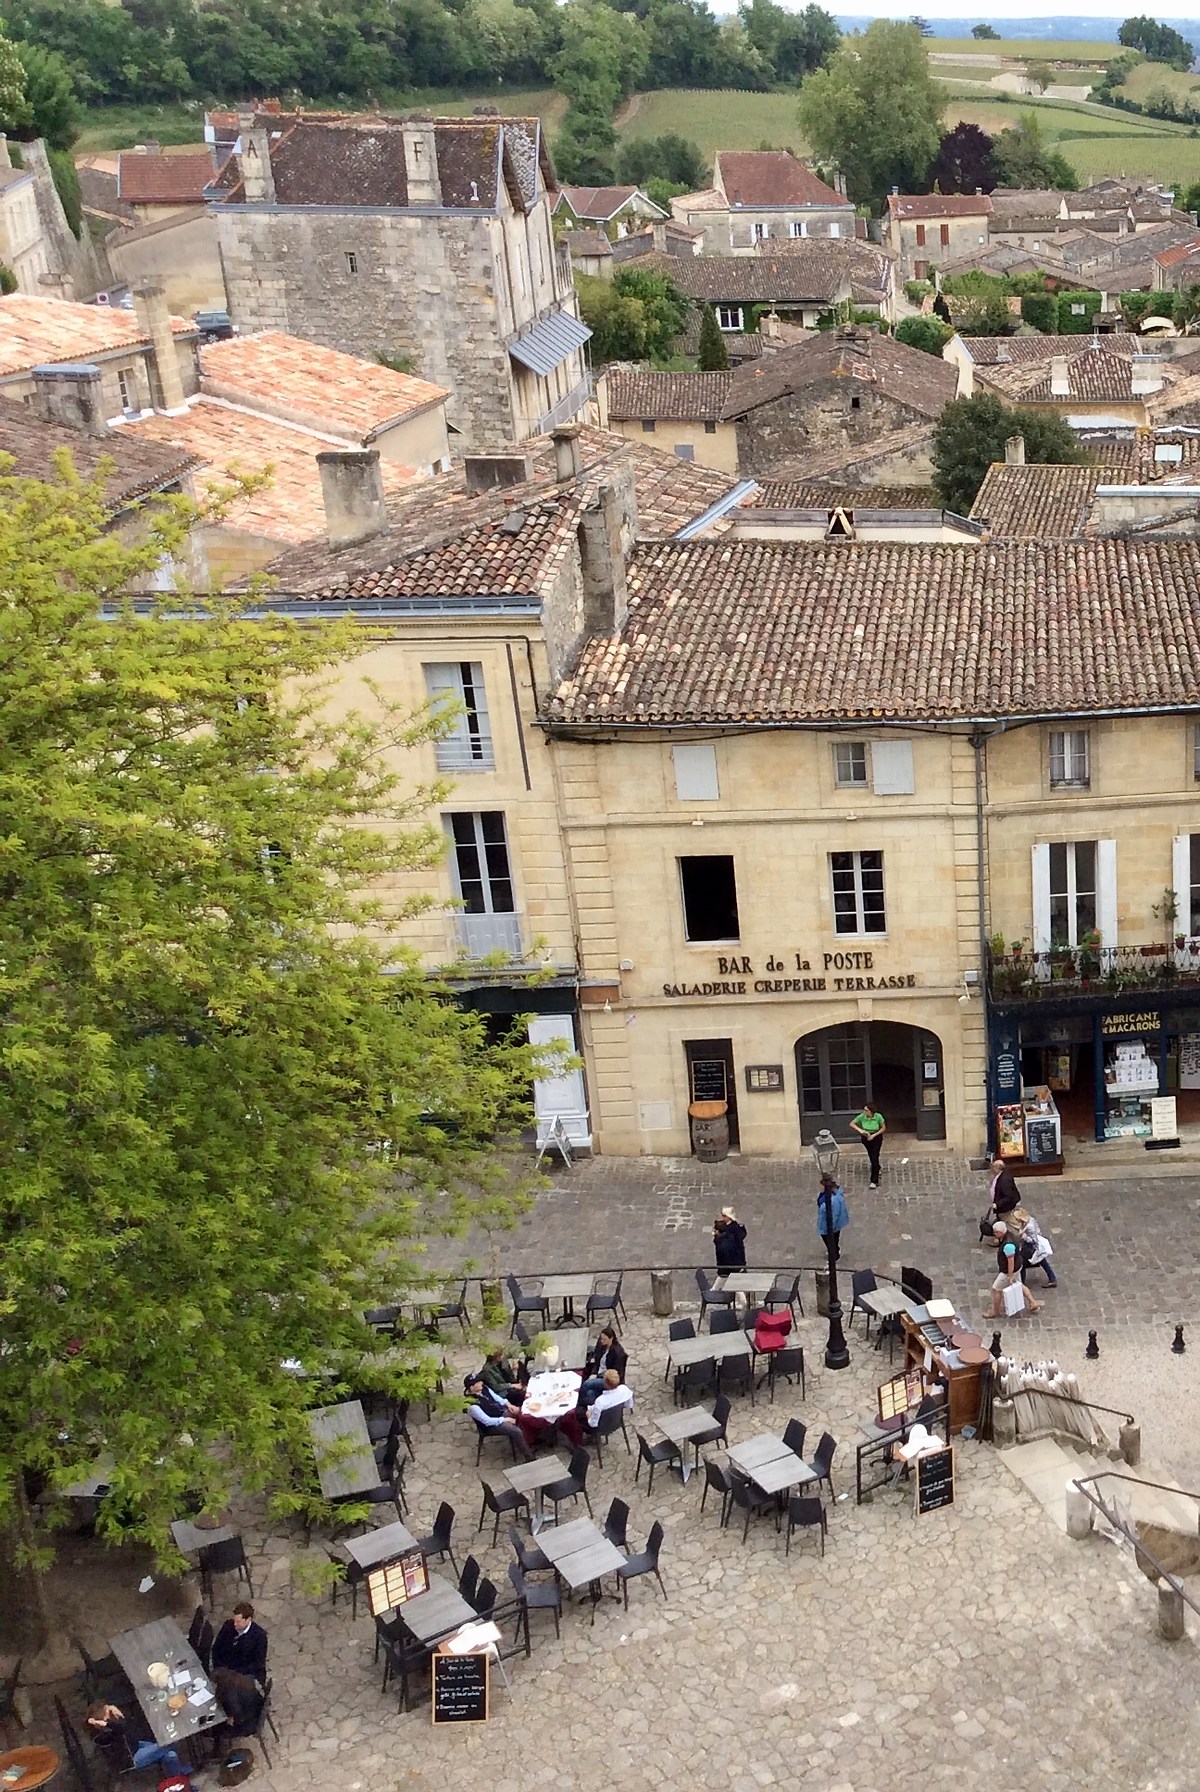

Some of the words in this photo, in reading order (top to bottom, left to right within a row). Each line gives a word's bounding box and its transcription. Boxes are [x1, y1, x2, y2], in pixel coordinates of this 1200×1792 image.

[718, 957, 753, 976] BAR
[766, 955, 784, 971] de
[796, 953, 811, 970] la
[823, 952, 874, 971] POSTE
[662, 981, 747, 997] SALADERIE
[753, 978, 827, 994] CREPERIE
[834, 974, 916, 992] TERRASSE
[1109, 1020, 1161, 1034] MACARONS
